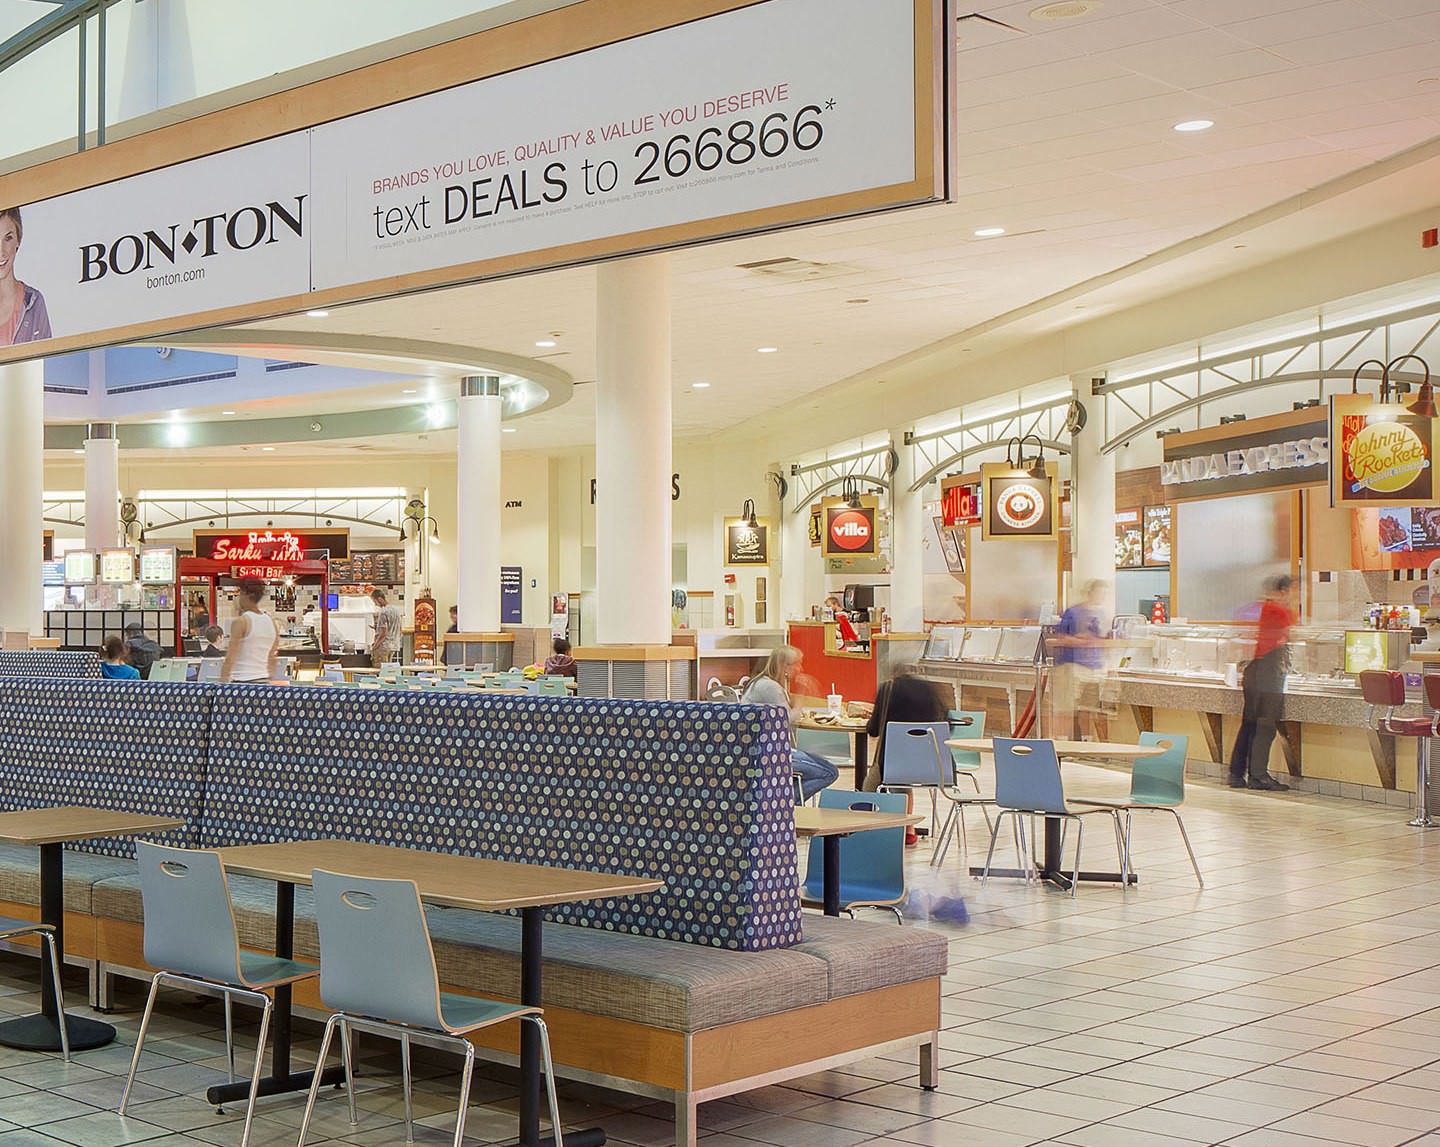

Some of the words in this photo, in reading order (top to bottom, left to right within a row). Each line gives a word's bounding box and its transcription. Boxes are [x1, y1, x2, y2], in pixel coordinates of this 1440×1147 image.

[372, 168, 429, 195] BRANDS
[433, 159, 464, 180] YOU
[468, 150, 510, 173] LOVE,
[514, 132, 581, 162] QUALITY
[585, 129, 597, 146] &
[600, 115, 654, 142] VALUE
[659, 105, 697, 128] YOU
[703, 83, 790, 119] DESERVE
[372, 195, 432, 239] text
[445, 162, 568, 225] DEALS
[581, 159, 619, 196] to
[146, 267, 205, 289] bonton.com
[1160, 453, 1229, 485] PANDA
[1227, 437, 1329, 476] EXPRESS
[1347, 428, 1414, 481] Johnny
[942, 487, 971, 519] villa
[834, 522, 868, 536] villa
[213, 539, 263, 560] Sarku
[271, 549, 304, 561] JAPAN
[266, 567, 283, 578] Bar
